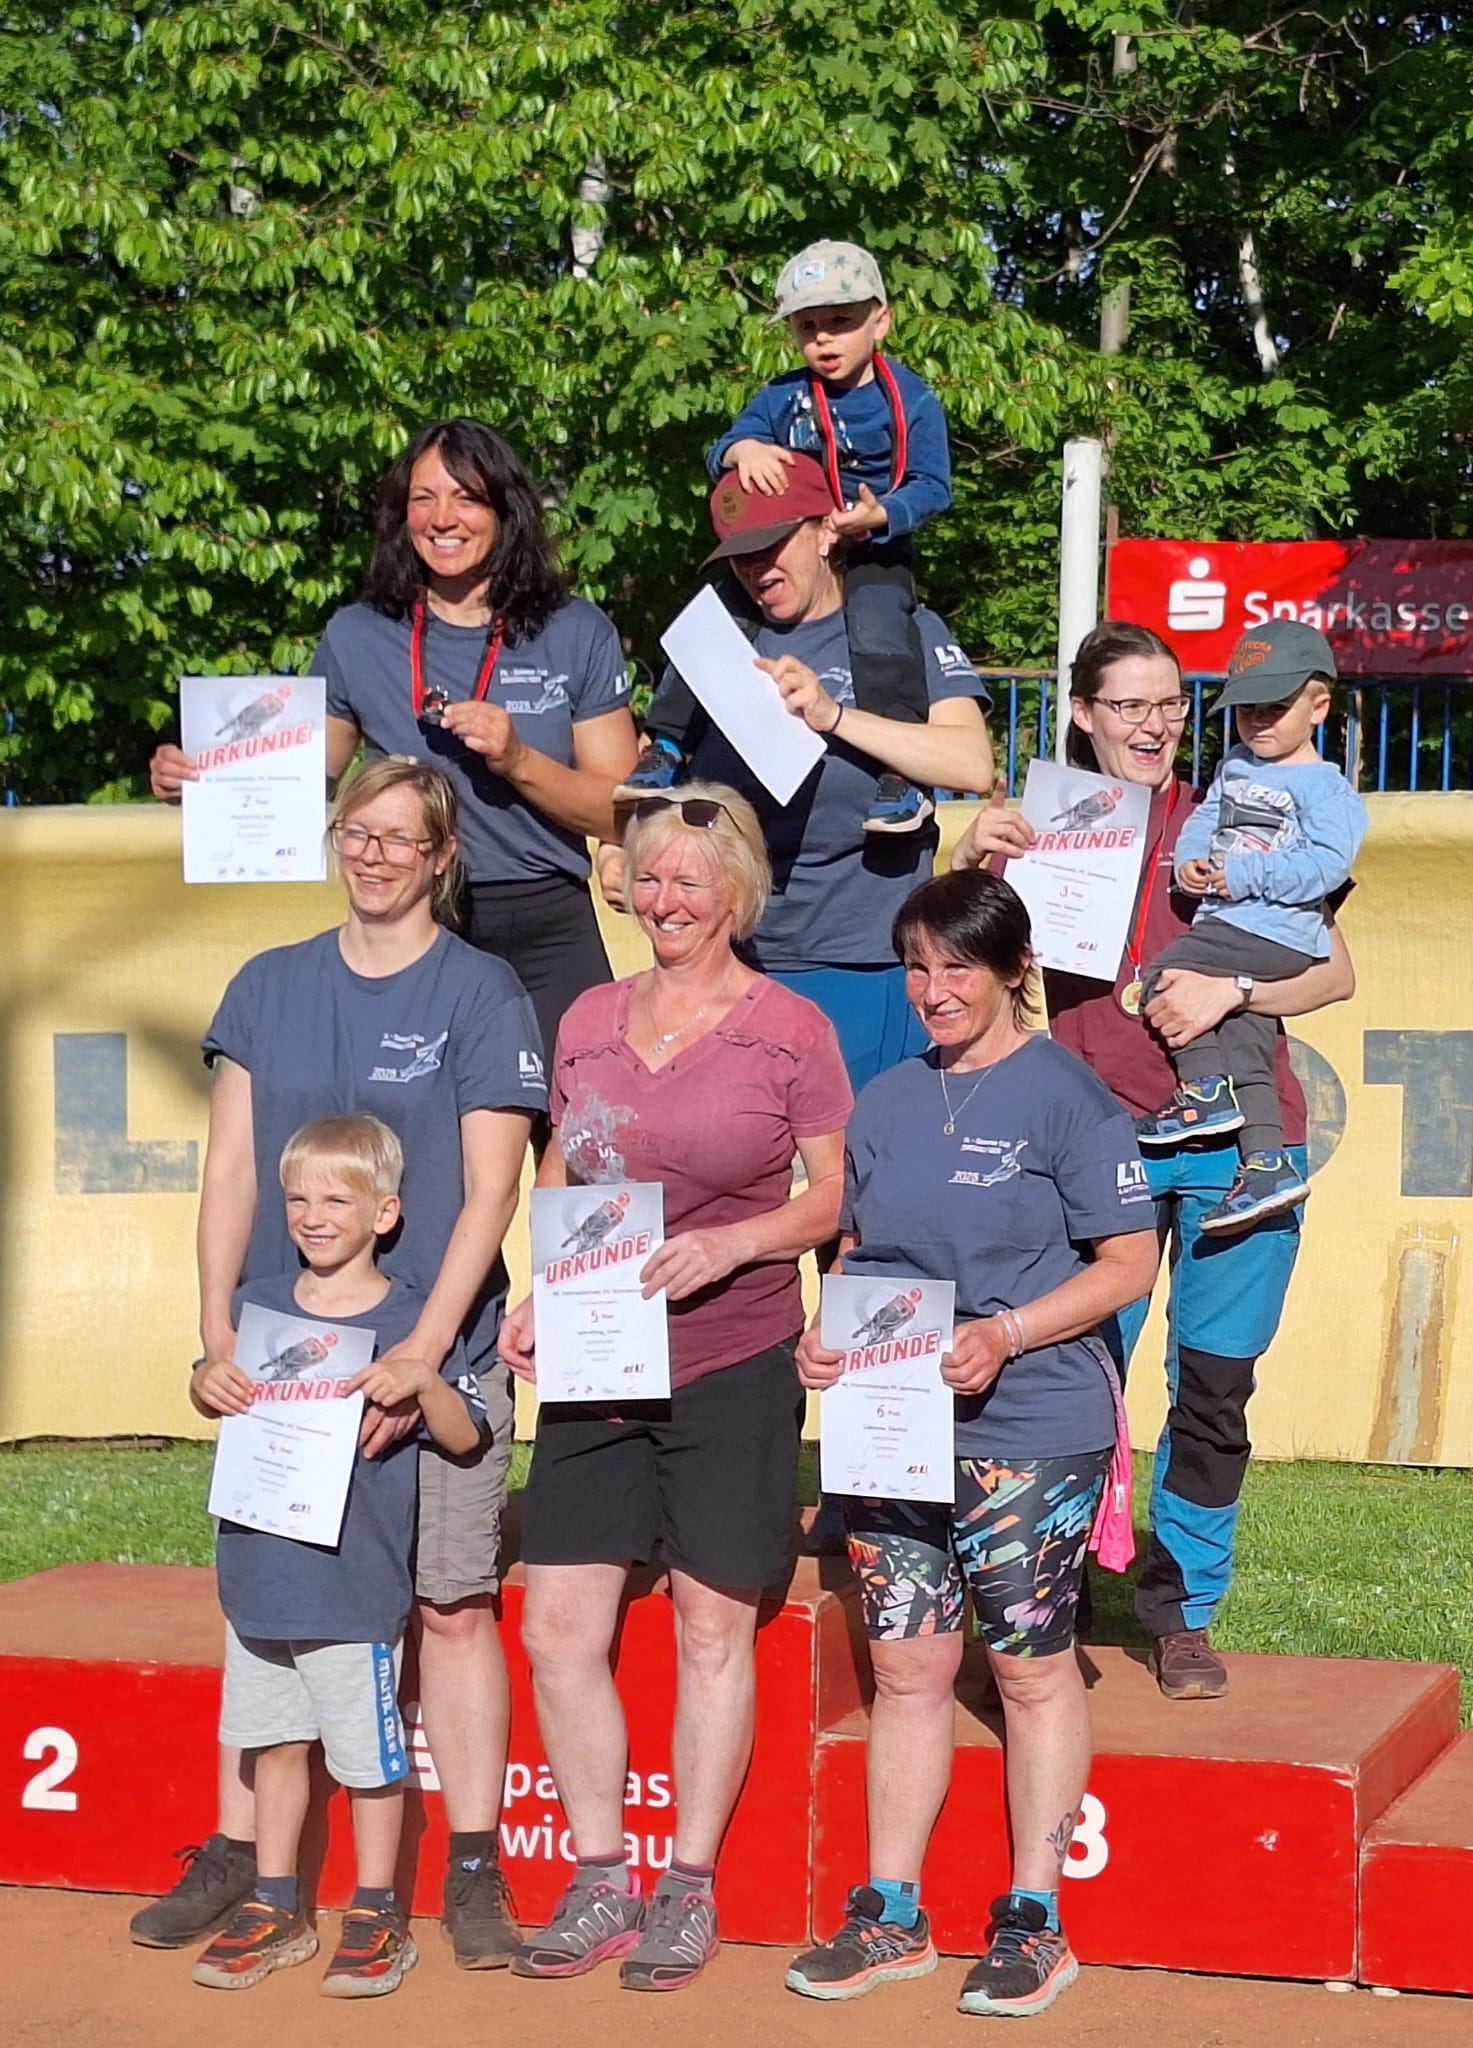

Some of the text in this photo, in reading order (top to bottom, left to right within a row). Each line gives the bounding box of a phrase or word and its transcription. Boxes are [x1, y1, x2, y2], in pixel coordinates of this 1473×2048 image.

[199, 726, 310, 771] URKUNDE
[546, 1233, 650, 1284] URKUNDE
[253, 1378, 350, 1401] RKUNDE
[23, 1727, 78, 1811] 2
